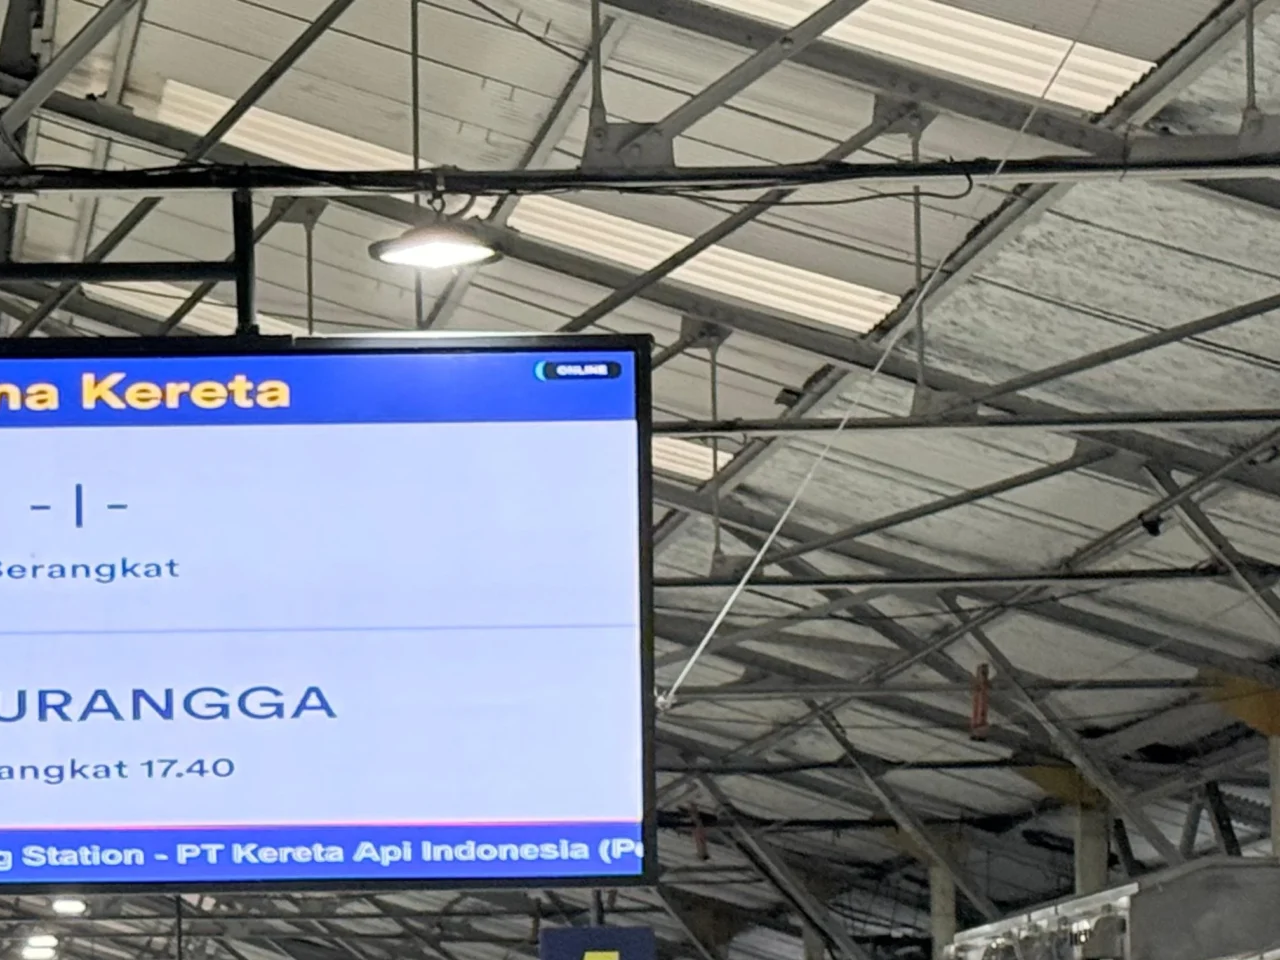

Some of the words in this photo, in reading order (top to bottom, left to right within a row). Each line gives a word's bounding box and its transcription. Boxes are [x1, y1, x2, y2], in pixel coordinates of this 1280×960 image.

[82, 373, 292, 409] Kereta
[140, 758, 235, 779] 17.40
[22, 844, 145, 867] Station
[176, 842, 226, 865] PT
[232, 841, 344, 864] Kereta
[352, 840, 413, 866] Api
[421, 838, 590, 863] Indonesia
